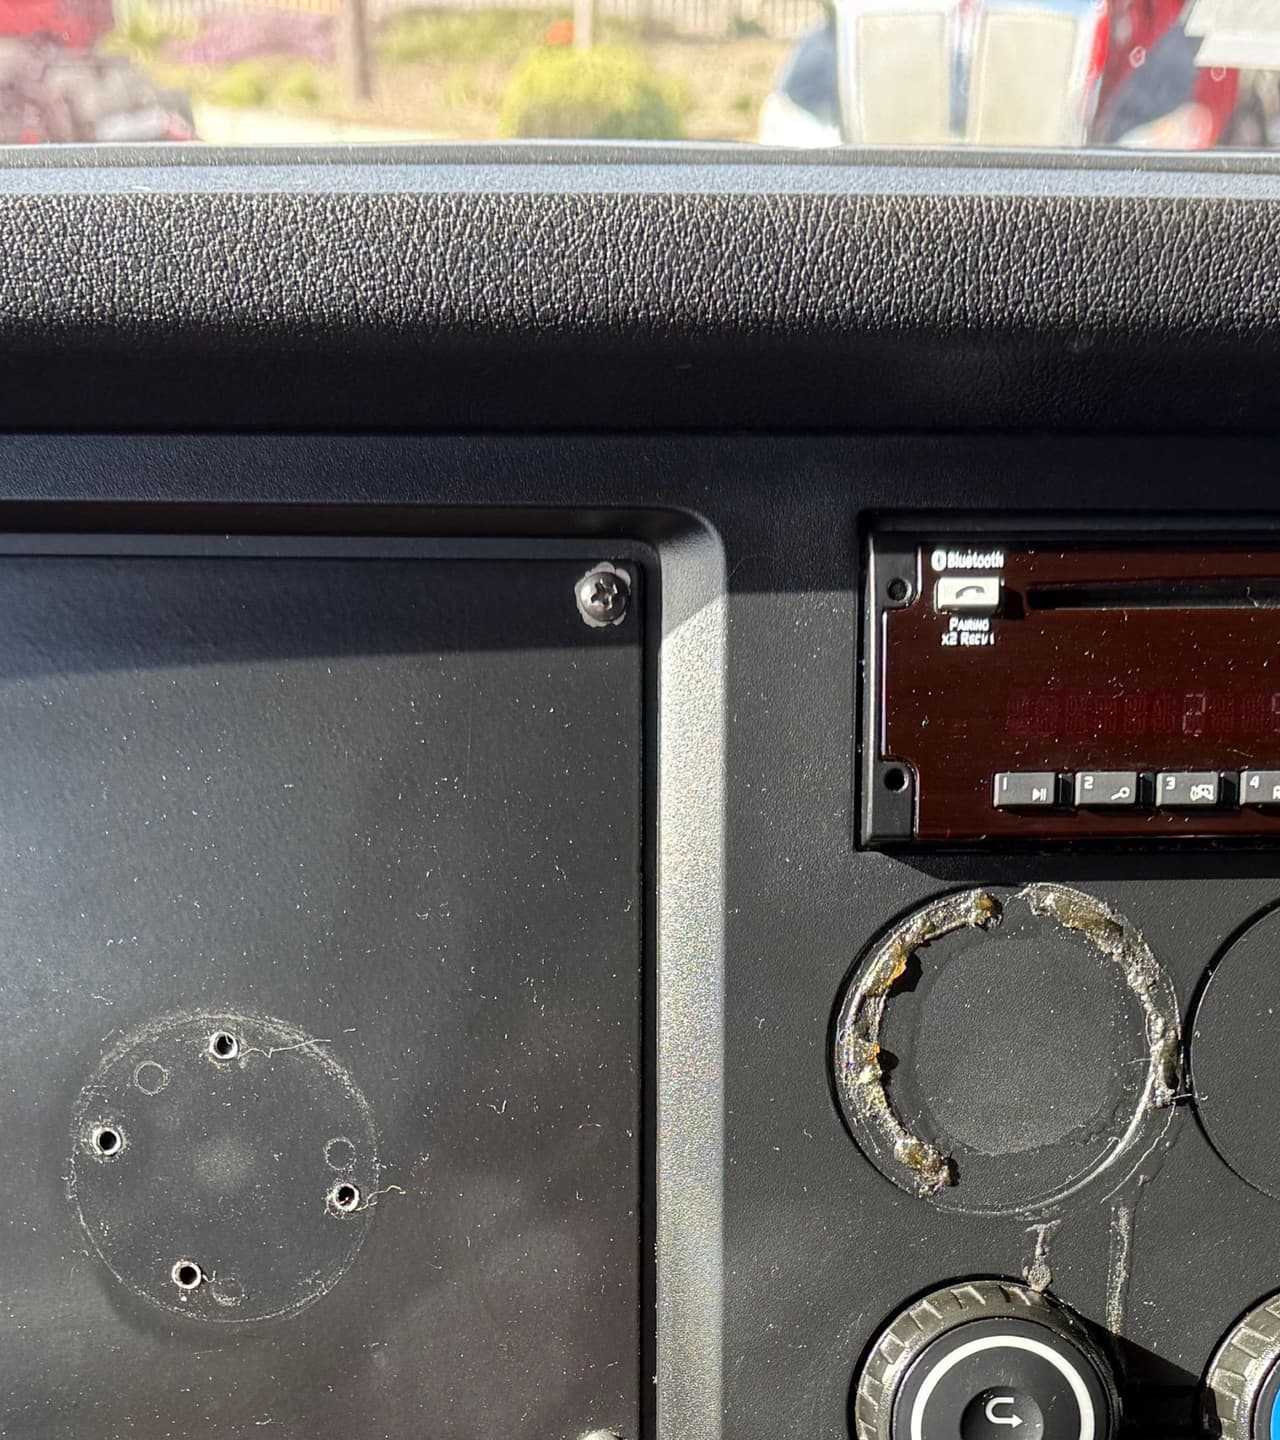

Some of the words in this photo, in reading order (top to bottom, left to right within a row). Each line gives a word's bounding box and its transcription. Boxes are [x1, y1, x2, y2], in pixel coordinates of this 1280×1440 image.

[947, 549, 1004, 568] Bluetooth
[1084, 776, 1093, 789] 2
[1165, 777, 1176, 790] 3
[1249, 776, 1260, 789] 4
